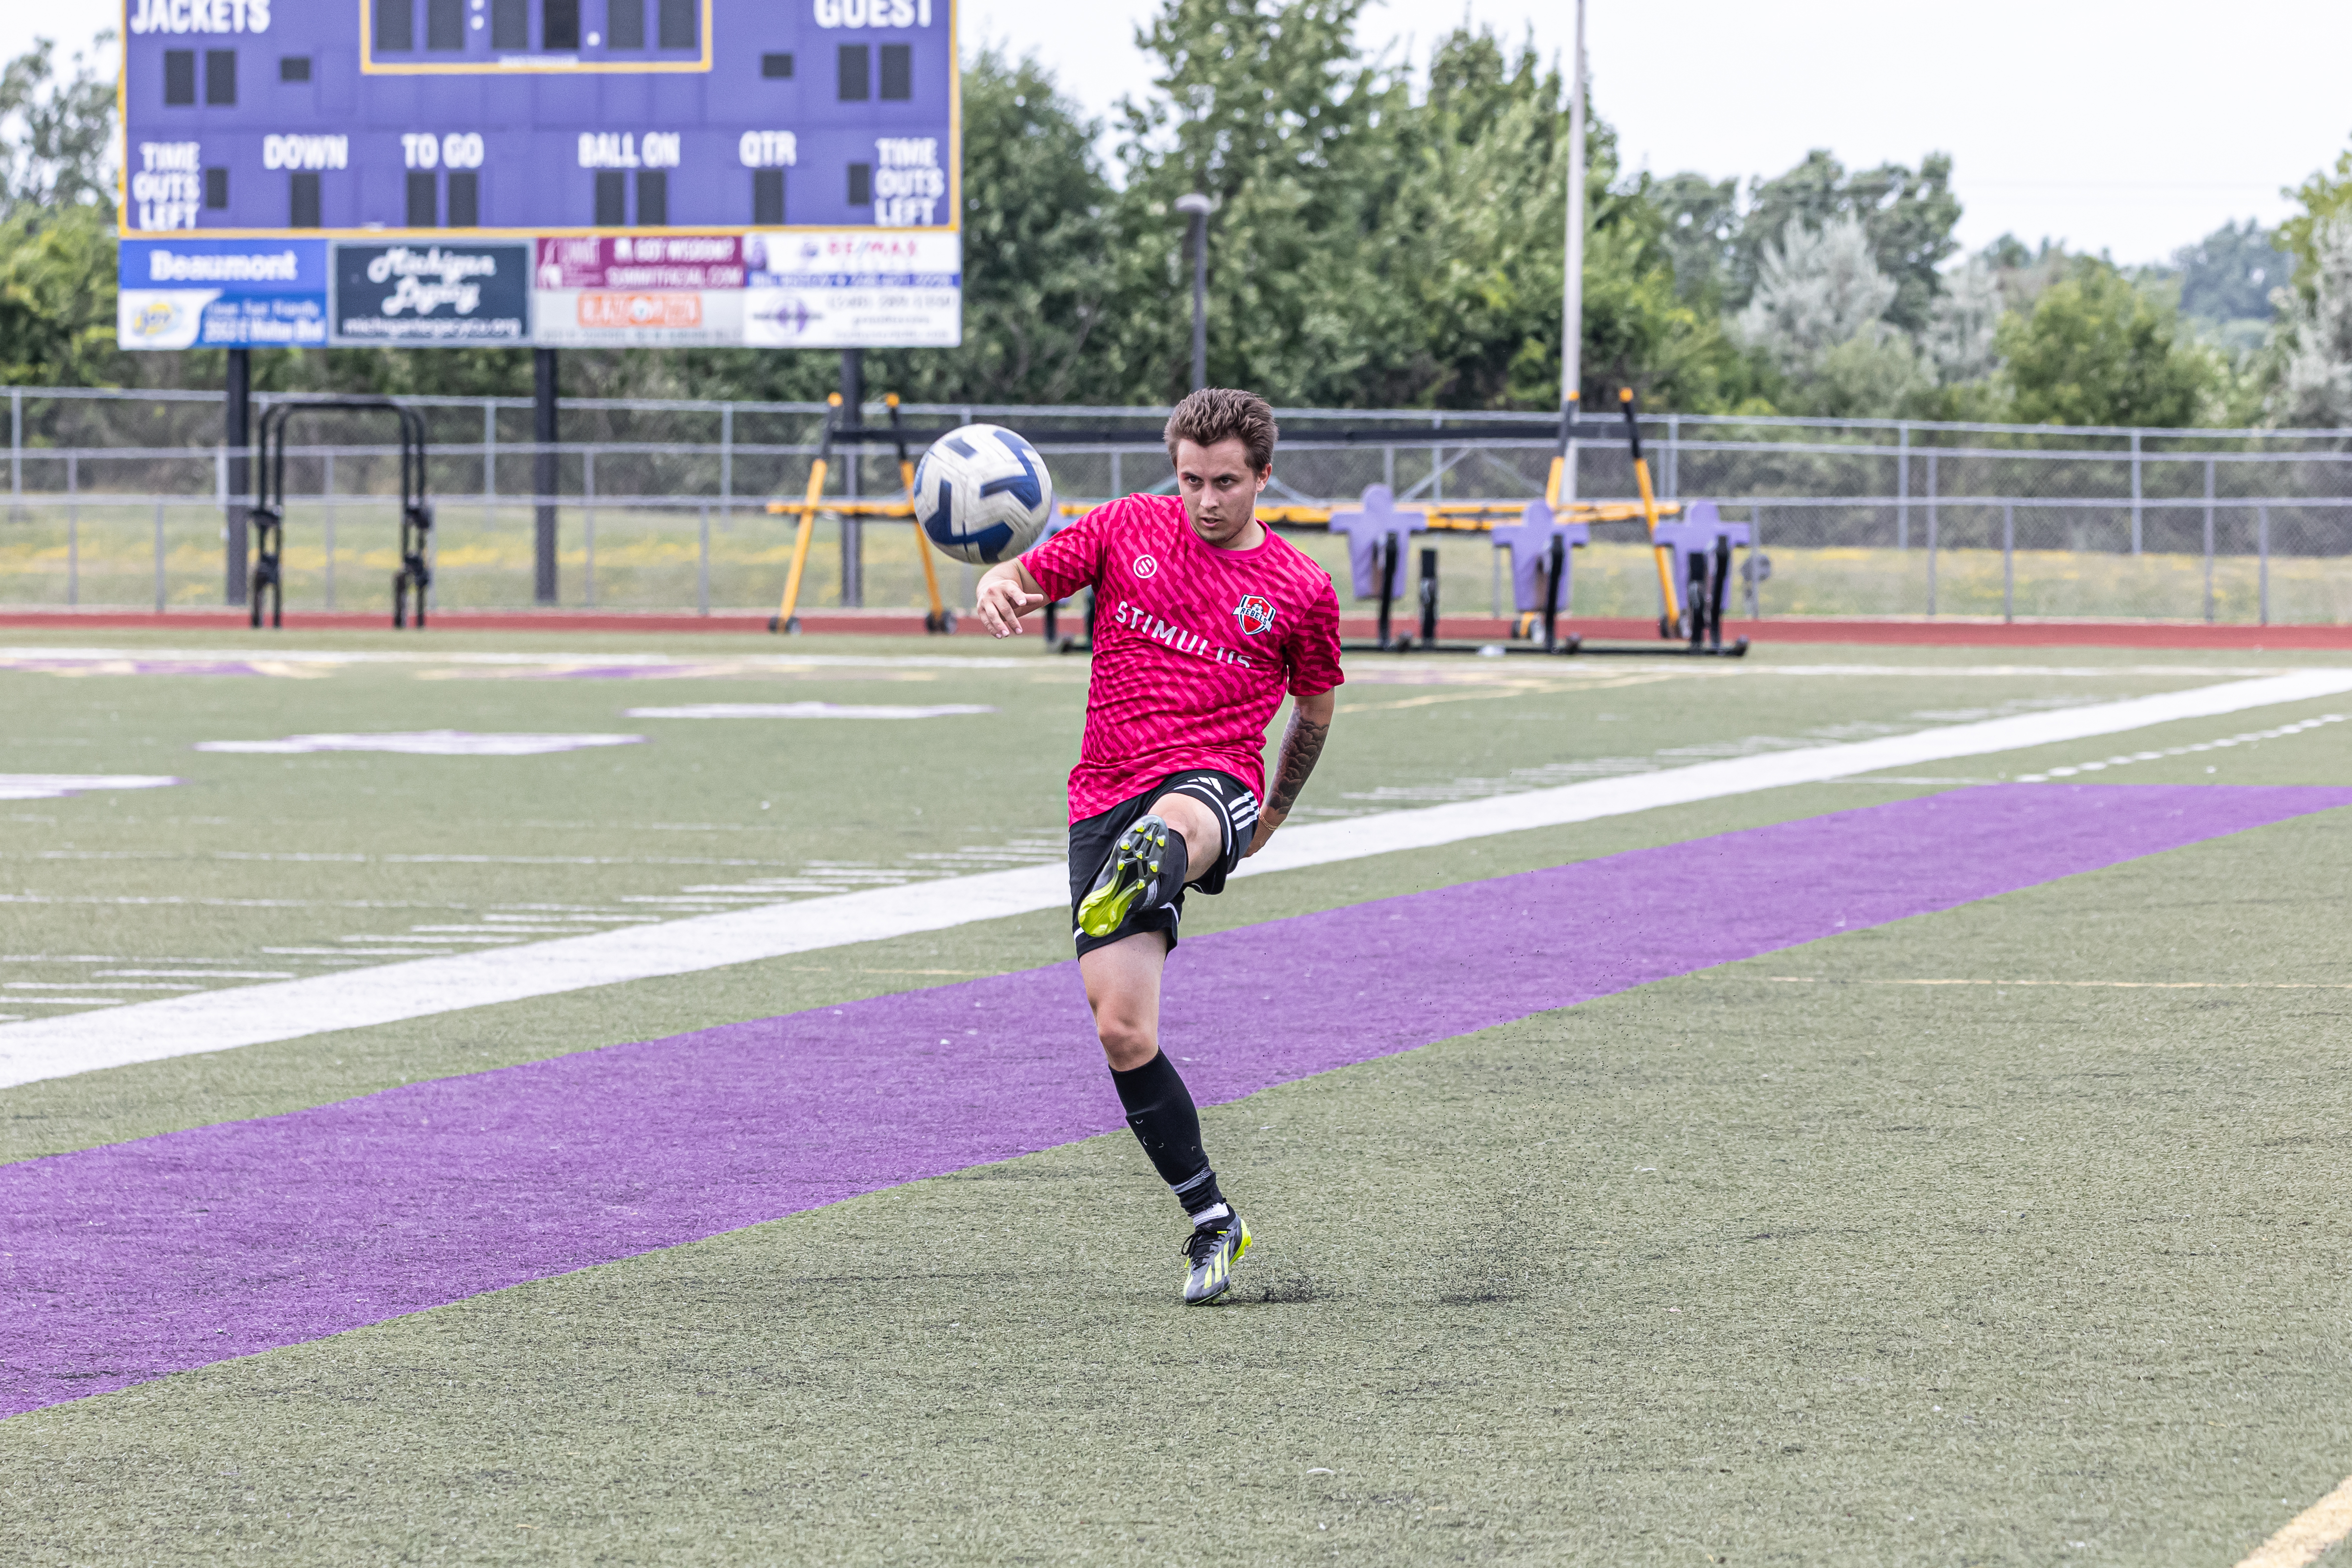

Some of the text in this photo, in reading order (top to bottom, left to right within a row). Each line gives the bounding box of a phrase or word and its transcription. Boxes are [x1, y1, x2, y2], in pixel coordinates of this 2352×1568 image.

[131, 0, 271, 34] JACKETS
[813, 0, 932, 28] GUEST
[138, 141, 200, 171] TIME
[263, 134, 348, 170] DOWN
[401, 132, 484, 169] TO GO
[578, 131, 680, 168] BALL ON
[739, 130, 796, 167] QTR
[875, 138, 938, 167] TIME
[132, 171, 200, 203] OUTS
[875, 167, 944, 198] OUTS
[139, 203, 200, 231] LEFT
[875, 198, 937, 227] LEFT
[150, 250, 297, 281] Beaumont
[1240, 608, 1267, 625] REBELS
